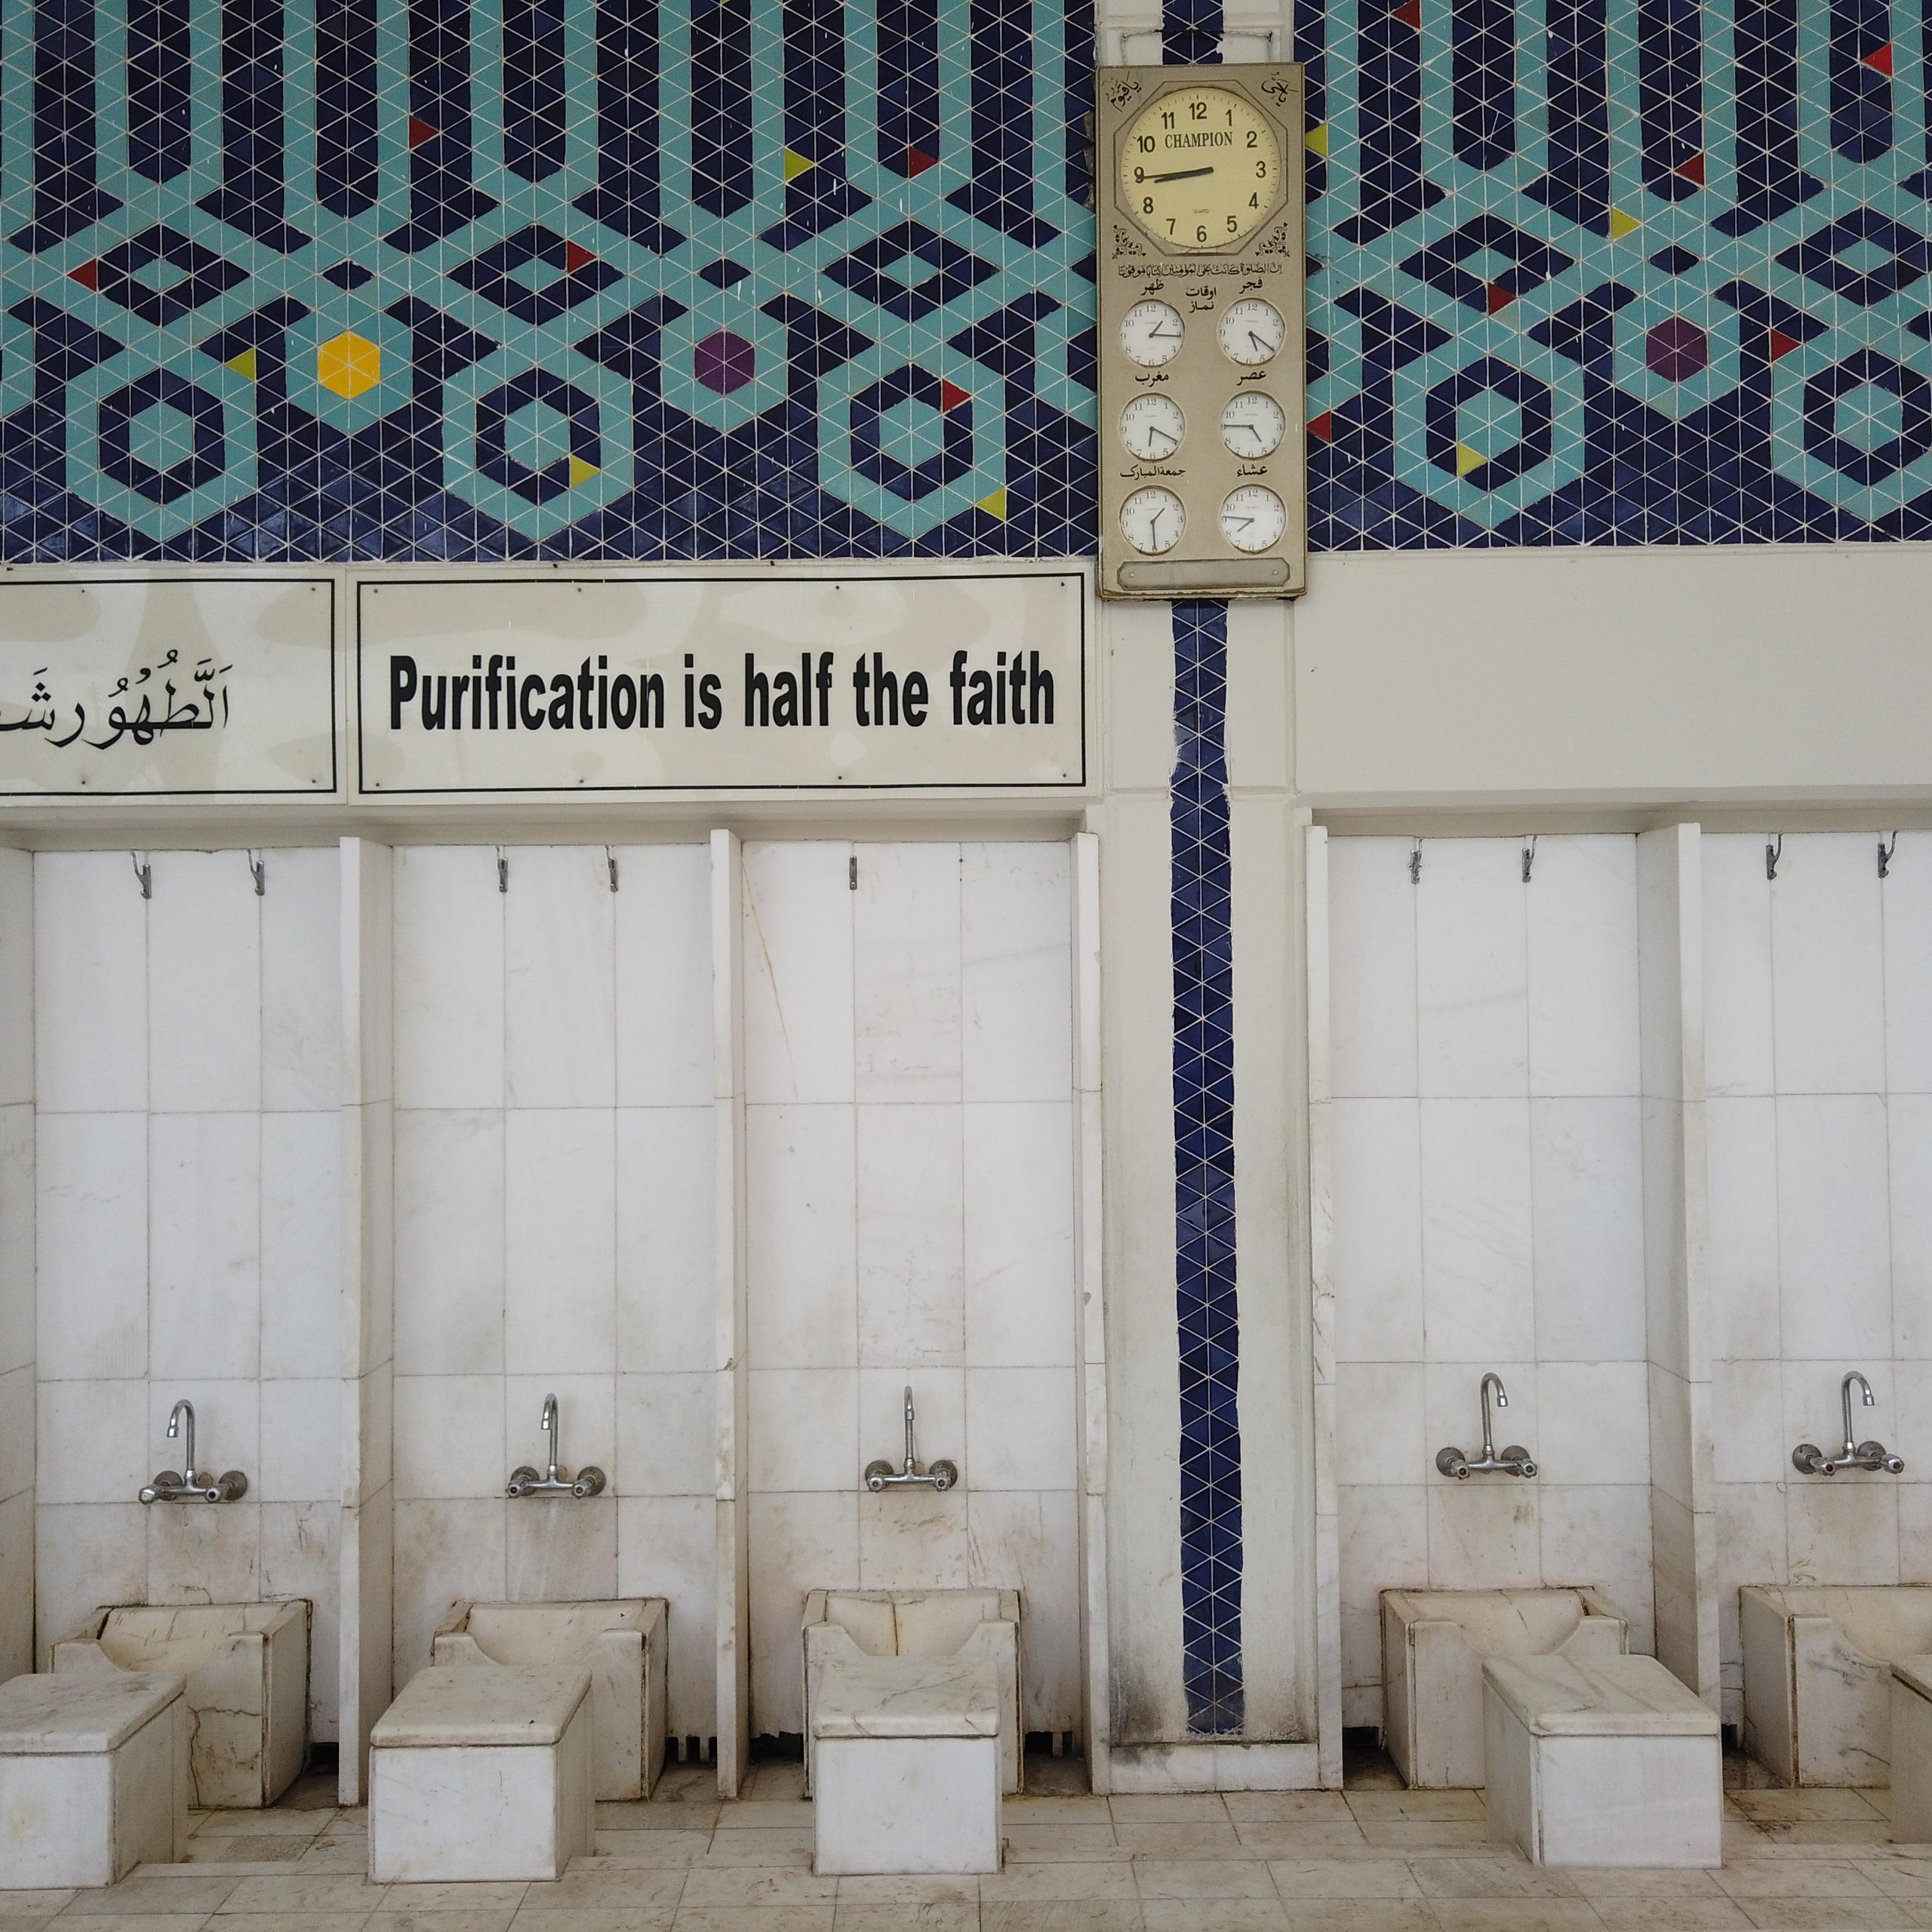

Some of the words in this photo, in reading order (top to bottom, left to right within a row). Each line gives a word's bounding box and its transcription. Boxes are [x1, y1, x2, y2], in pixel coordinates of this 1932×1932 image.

[1189, 103, 1208, 120] 12
[1226, 109, 1232, 127] 1
[1161, 112, 1174, 130] 11
[1137, 136, 1155, 152] 10
[1165, 131, 1233, 149] CHAMPION
[1247, 131, 1257, 148] 2
[1134, 167, 1144, 183] 9
[1256, 161, 1266, 178] 3
[1143, 196, 1153, 214] 8
[1248, 192, 1259, 208] 4
[1167, 218, 1176, 235] 7
[1227, 216, 1238, 232] 5
[1197, 225, 1207, 242] 6
[1140, 278, 1164, 296] ظهر
[1186, 285, 1217, 300] اوقات
[1238, 276, 1263, 294] فجر
[1189, 301, 1214, 313] نماز
[1135, 371, 1169, 387] مغرب
[1236, 371, 1266, 386] عصر
[1237, 464, 1268, 477] عشاء
[390, 654, 664, 730] Purification
[684, 654, 722, 730] is
[745, 651, 834, 727] half
[853, 651, 928, 727] the
[949, 650, 1054, 725] faith
